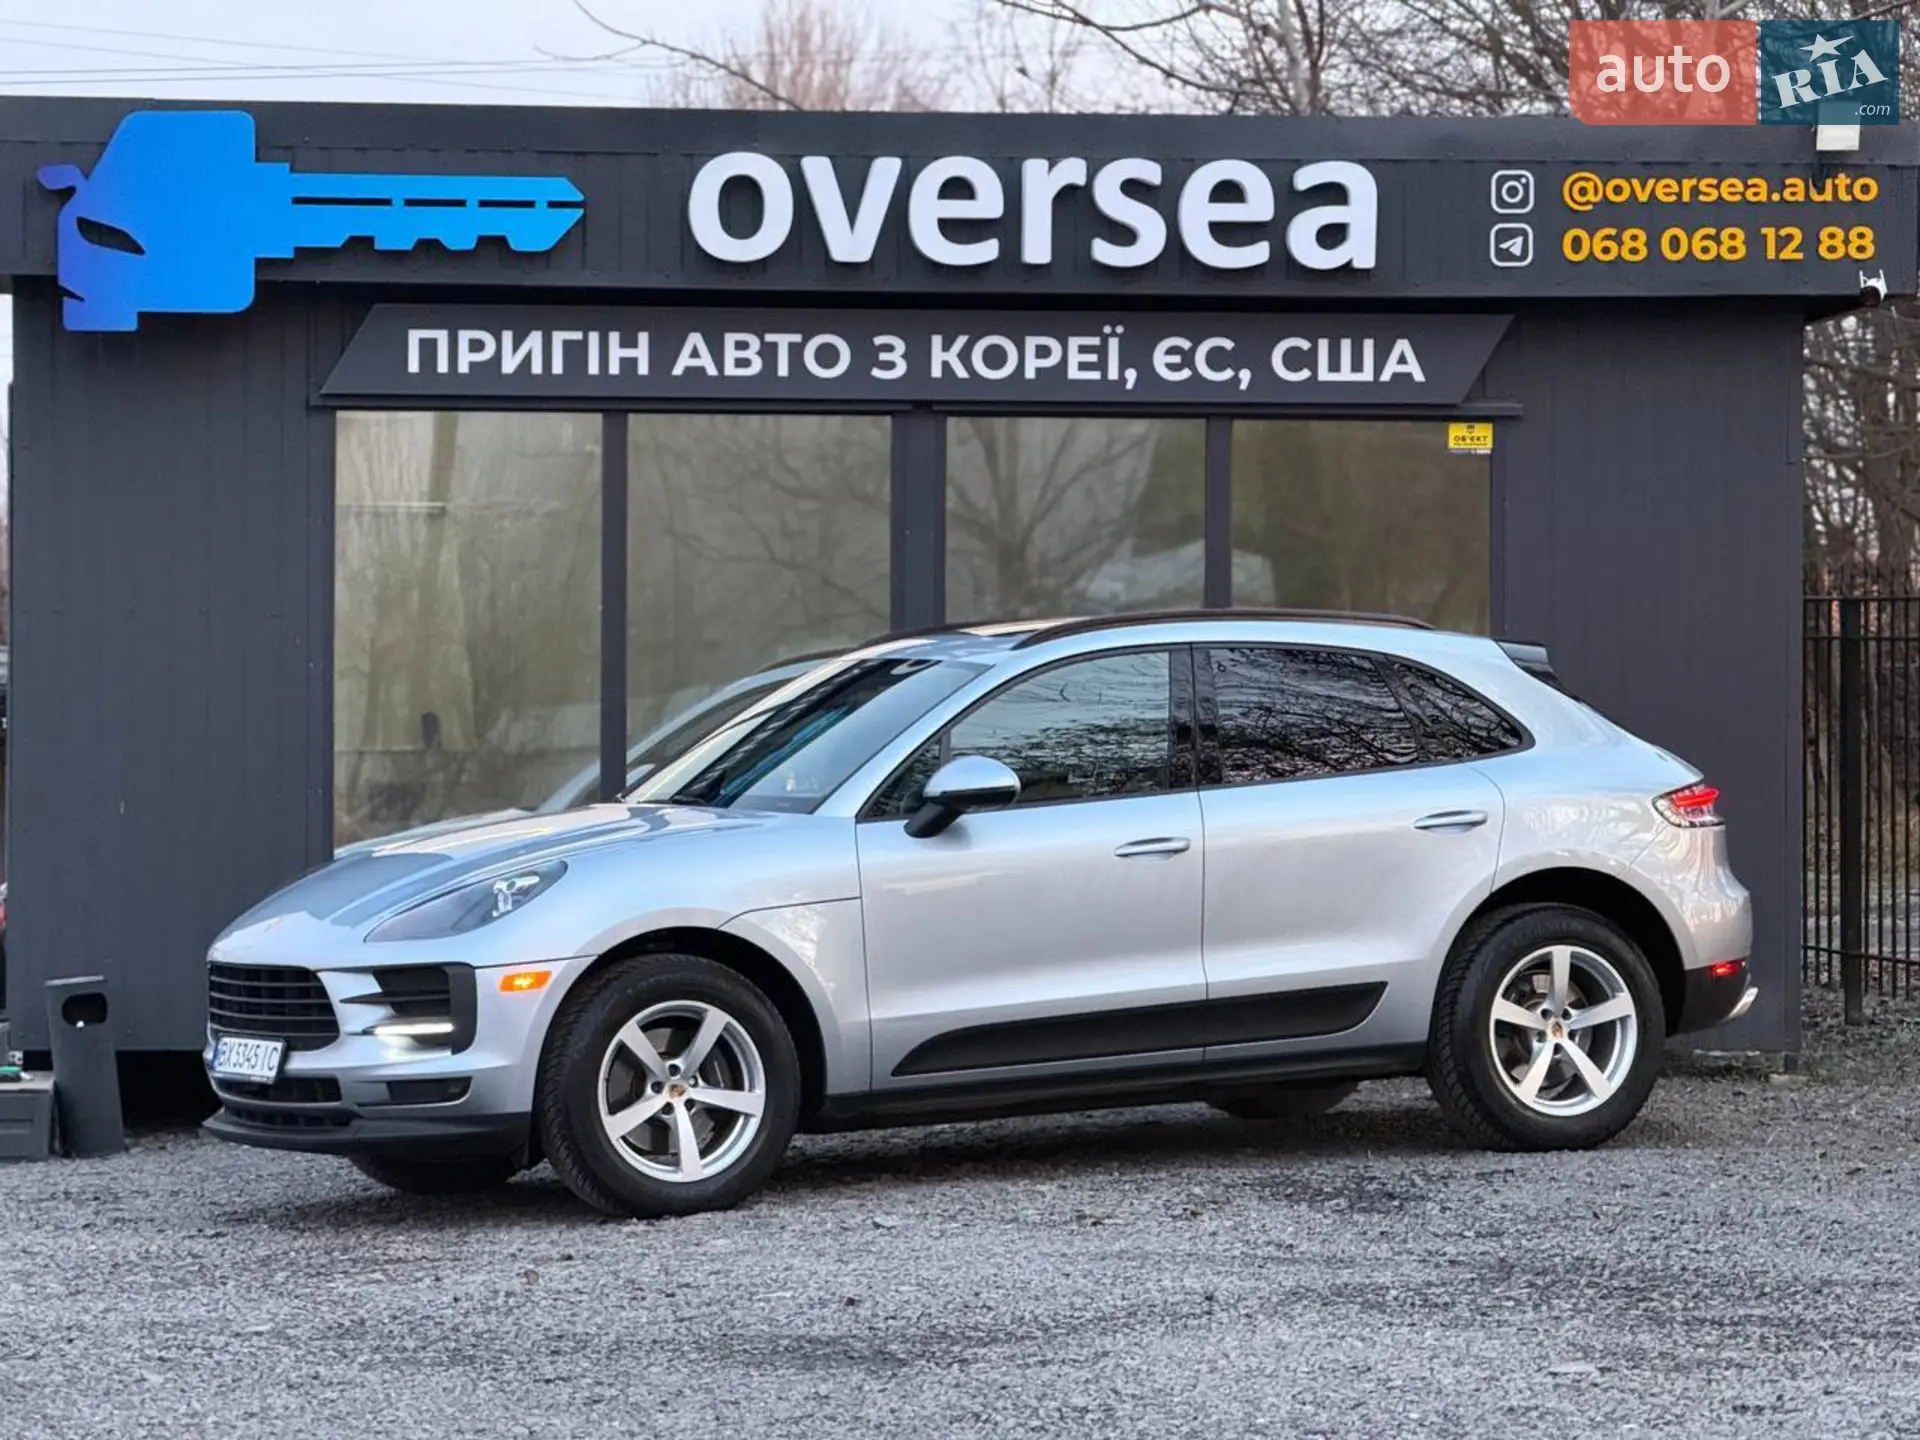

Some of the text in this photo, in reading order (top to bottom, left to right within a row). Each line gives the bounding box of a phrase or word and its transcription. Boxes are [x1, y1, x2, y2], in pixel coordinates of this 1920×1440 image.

[689, 151, 1379, 270] oversea
[1562, 171, 1879, 211] @oversea.auto
[1562, 226, 1876, 262] 068 068 12 88
[407, 324, 1426, 391] ПРИГІН АВТО З КОРЕЇ, ЄС, США
[233, 1042, 260, 1070] 5345
